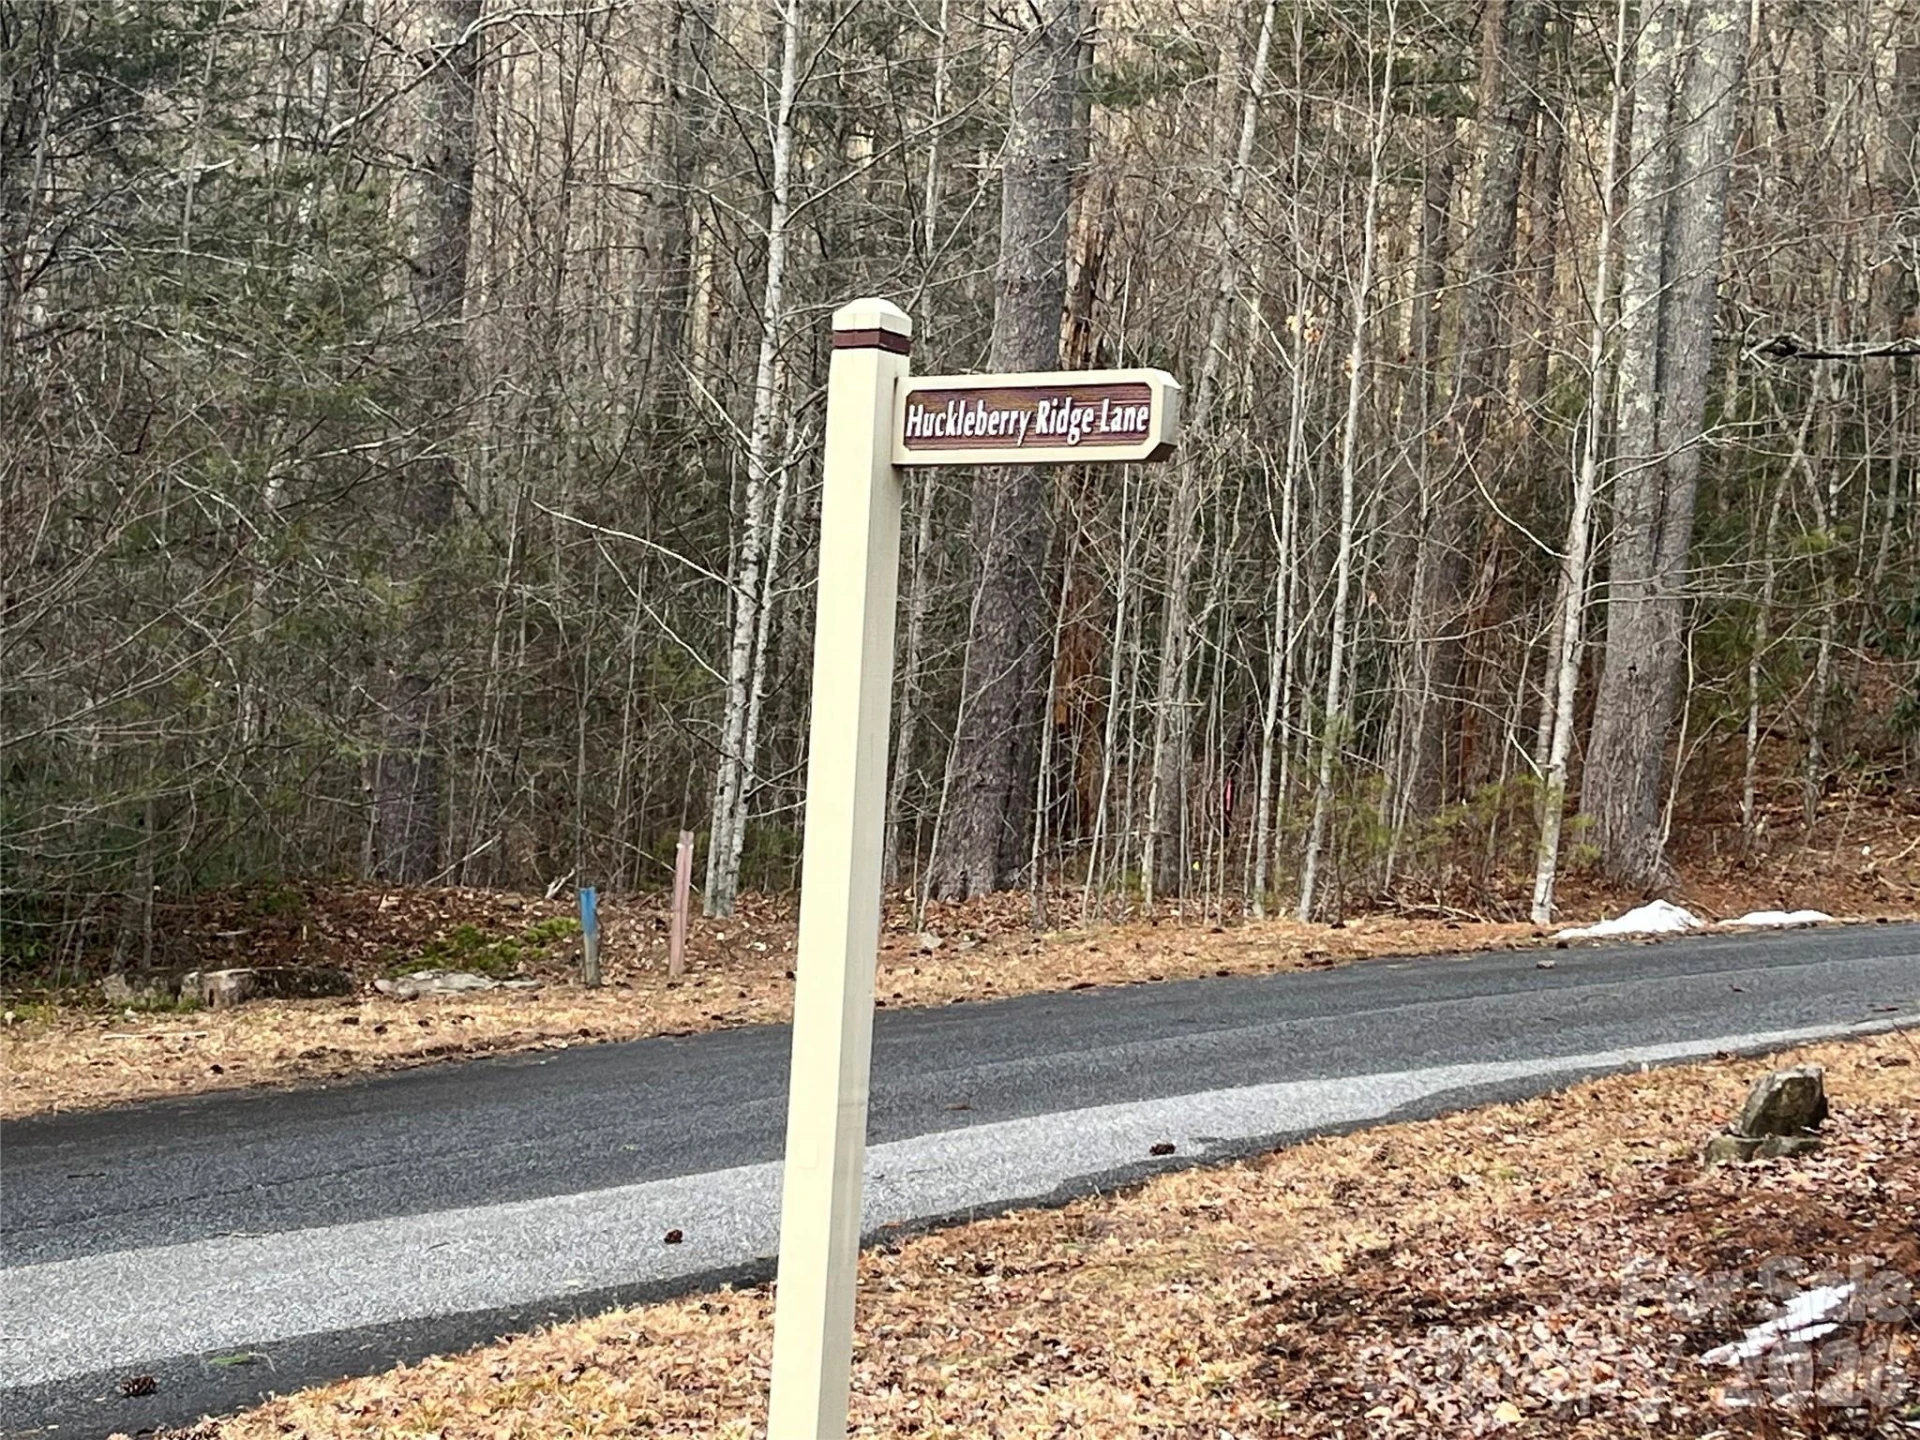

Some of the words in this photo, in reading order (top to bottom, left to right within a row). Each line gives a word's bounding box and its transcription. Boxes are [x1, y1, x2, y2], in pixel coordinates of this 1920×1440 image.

[906, 399, 1033, 447] Huckleberry
[1035, 396, 1094, 446] Ridge
[1101, 398, 1150, 433] Lane
